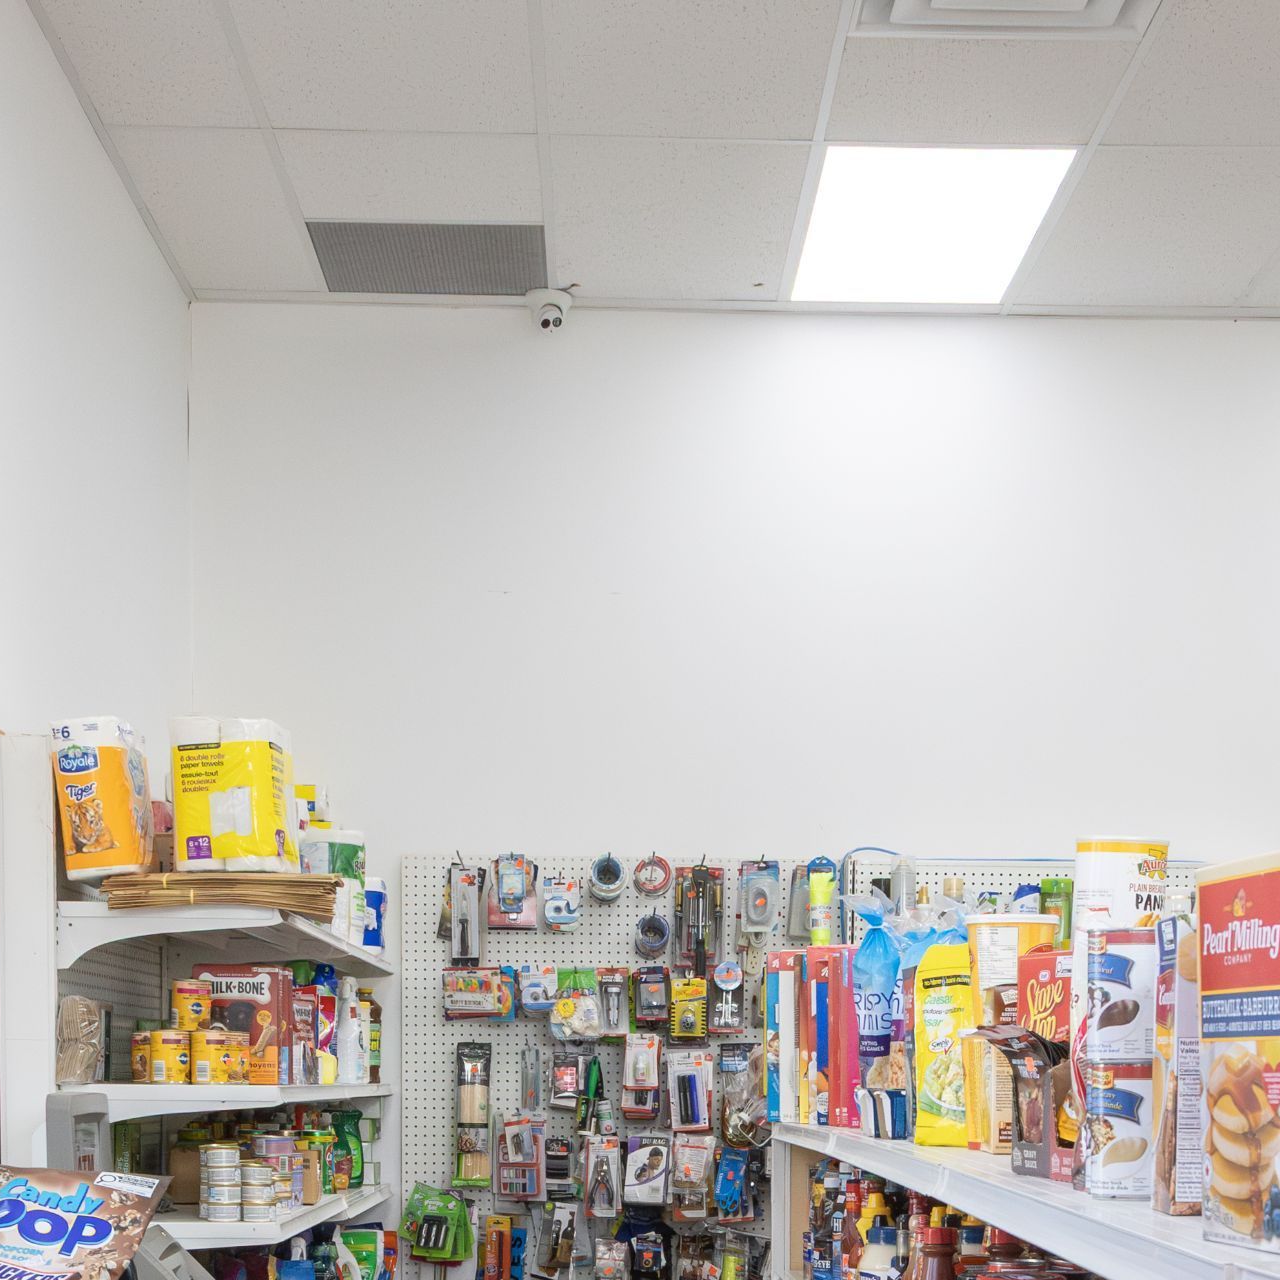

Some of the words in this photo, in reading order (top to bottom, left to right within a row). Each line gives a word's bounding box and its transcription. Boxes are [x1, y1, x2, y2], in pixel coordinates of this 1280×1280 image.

[58, 754, 96, 773] Royale
[65, 782, 96, 800] Tiger
[1203, 923, 1233, 955] Pearl
[1234, 918, 1280, 955] Milling
[1223, 953, 1253, 966] COMPANY
[212, 981, 233, 995] ILK
[237, 980, 265, 995] BONE
[1027, 978, 1064, 1010] Stove
[854, 991, 895, 1011] RISPY
